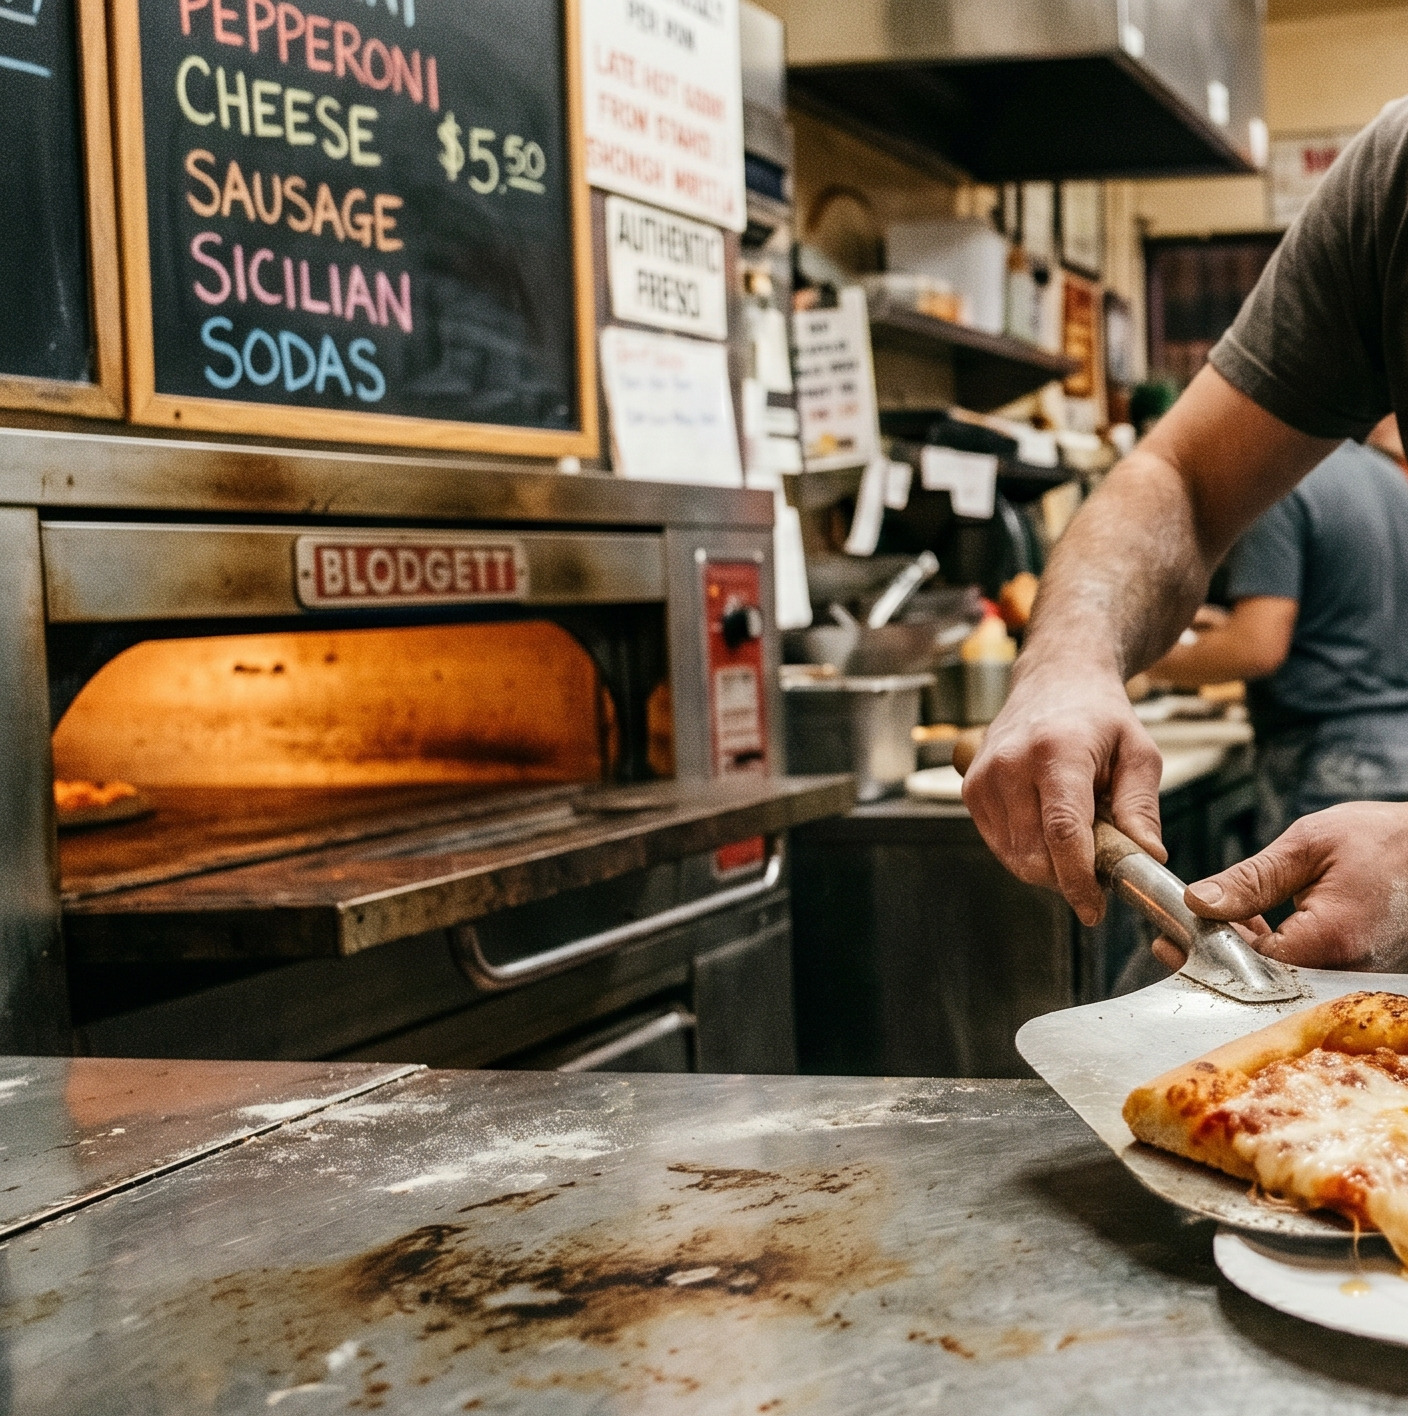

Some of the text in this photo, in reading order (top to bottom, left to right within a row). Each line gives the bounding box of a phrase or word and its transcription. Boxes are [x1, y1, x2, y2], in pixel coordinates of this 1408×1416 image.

[179, 0, 441, 111] PEPPERONI
[177, 55, 381, 167] CHEESE
[437, 110, 547, 195] $5.50
[185, 149, 405, 252] SAUSAGE
[190, 231, 413, 333] SICILIAN
[200, 316, 386, 402] SODAS
[320, 548, 511, 595] BLODGETT
